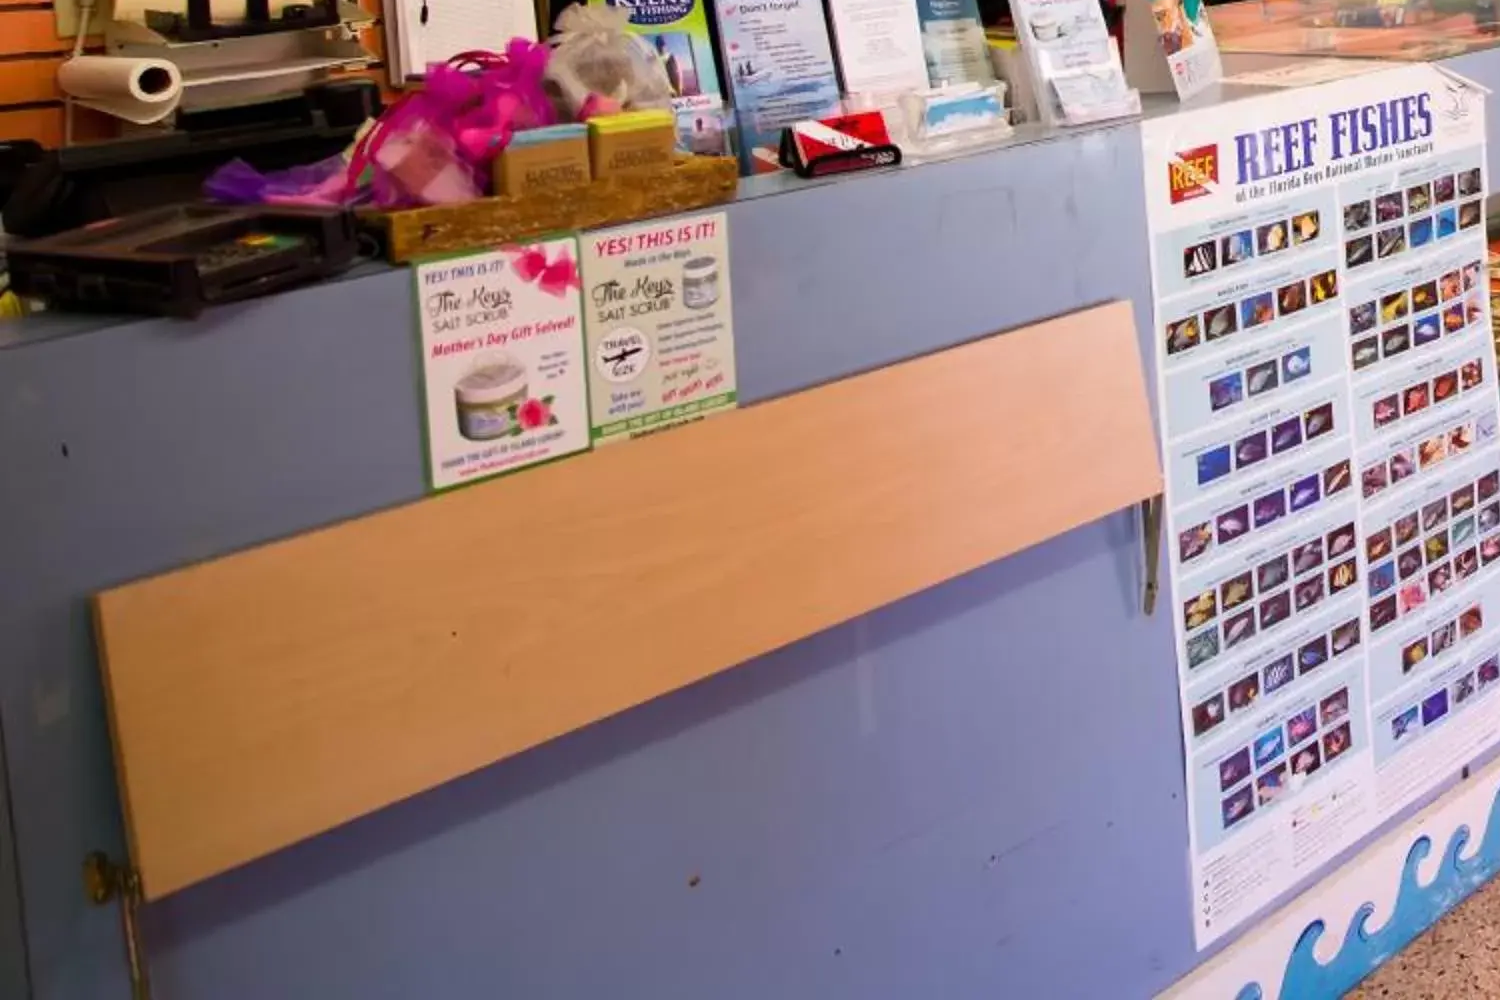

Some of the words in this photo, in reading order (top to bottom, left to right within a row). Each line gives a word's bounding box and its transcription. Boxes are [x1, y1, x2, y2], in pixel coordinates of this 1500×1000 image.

[1234, 118, 1317, 185] REEF
[1329, 92, 1432, 160] FISHES
[1172, 155, 1214, 190] REEF
[1269, 176, 1301, 195] Florida
[595, 237, 632, 257] YES!
[637, 229, 673, 249] THIS
[677, 225, 691, 241] IS
[696, 220, 715, 238] IT!
[425, 270, 448, 285] YES!
[451, 265, 474, 281] THIS
[477, 264, 488, 275] IS
[427, 291, 460, 317] The
[467, 285, 512, 310] Keys
[592, 280, 626, 308] The
[630, 275, 676, 299] Keys
[432, 316, 461, 334] SALT
[598, 305, 625, 322] SALT
[431, 337, 483, 359] Mother's
[487, 333, 508, 346] Day
[512, 325, 532, 341] Gift
